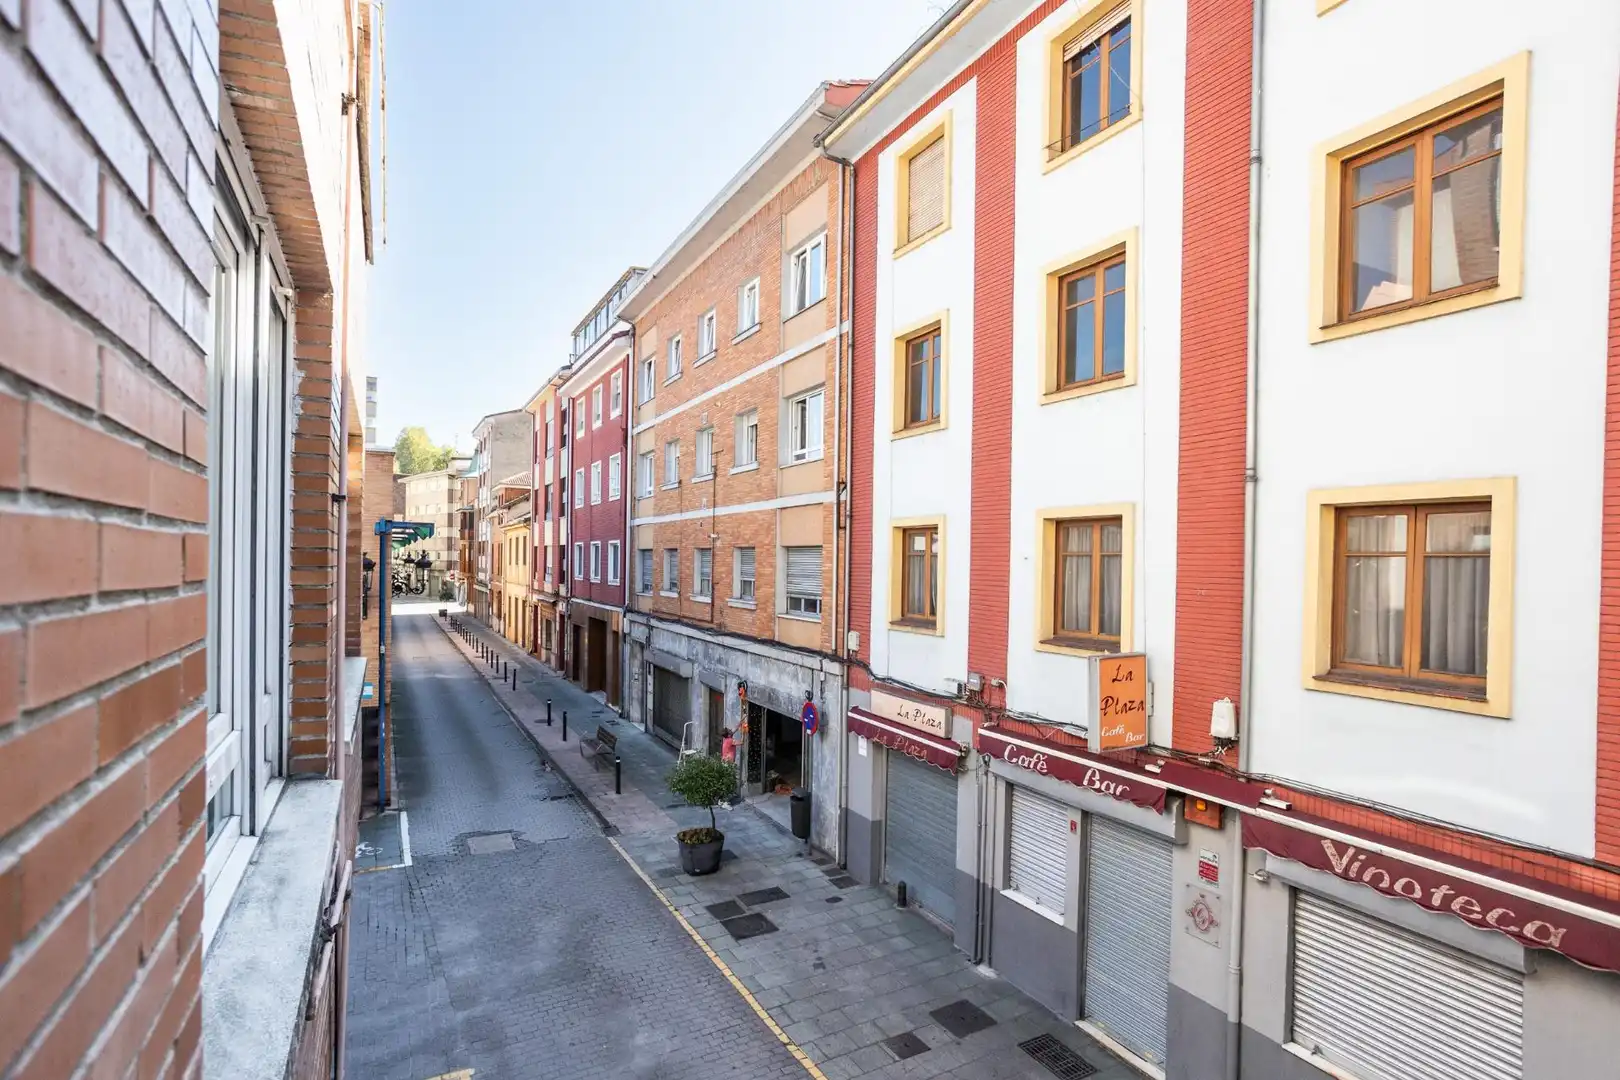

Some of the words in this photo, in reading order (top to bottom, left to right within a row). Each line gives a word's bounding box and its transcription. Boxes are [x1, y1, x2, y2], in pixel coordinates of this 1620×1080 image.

[1112, 664, 1134, 683] La
[896, 704, 910, 720] La
[913, 707, 942, 730] Plaza
[1100, 695, 1145, 716] Plaza
[873, 729, 887, 745] La
[893, 735, 927, 759] Plaza
[1101, 724, 1125, 737] Café
[1125, 731, 1145, 743] Bar
[1003, 744, 1048, 773] Café
[1082, 768, 1131, 797] Bar
[1321, 839, 1567, 947] Vinoteca
